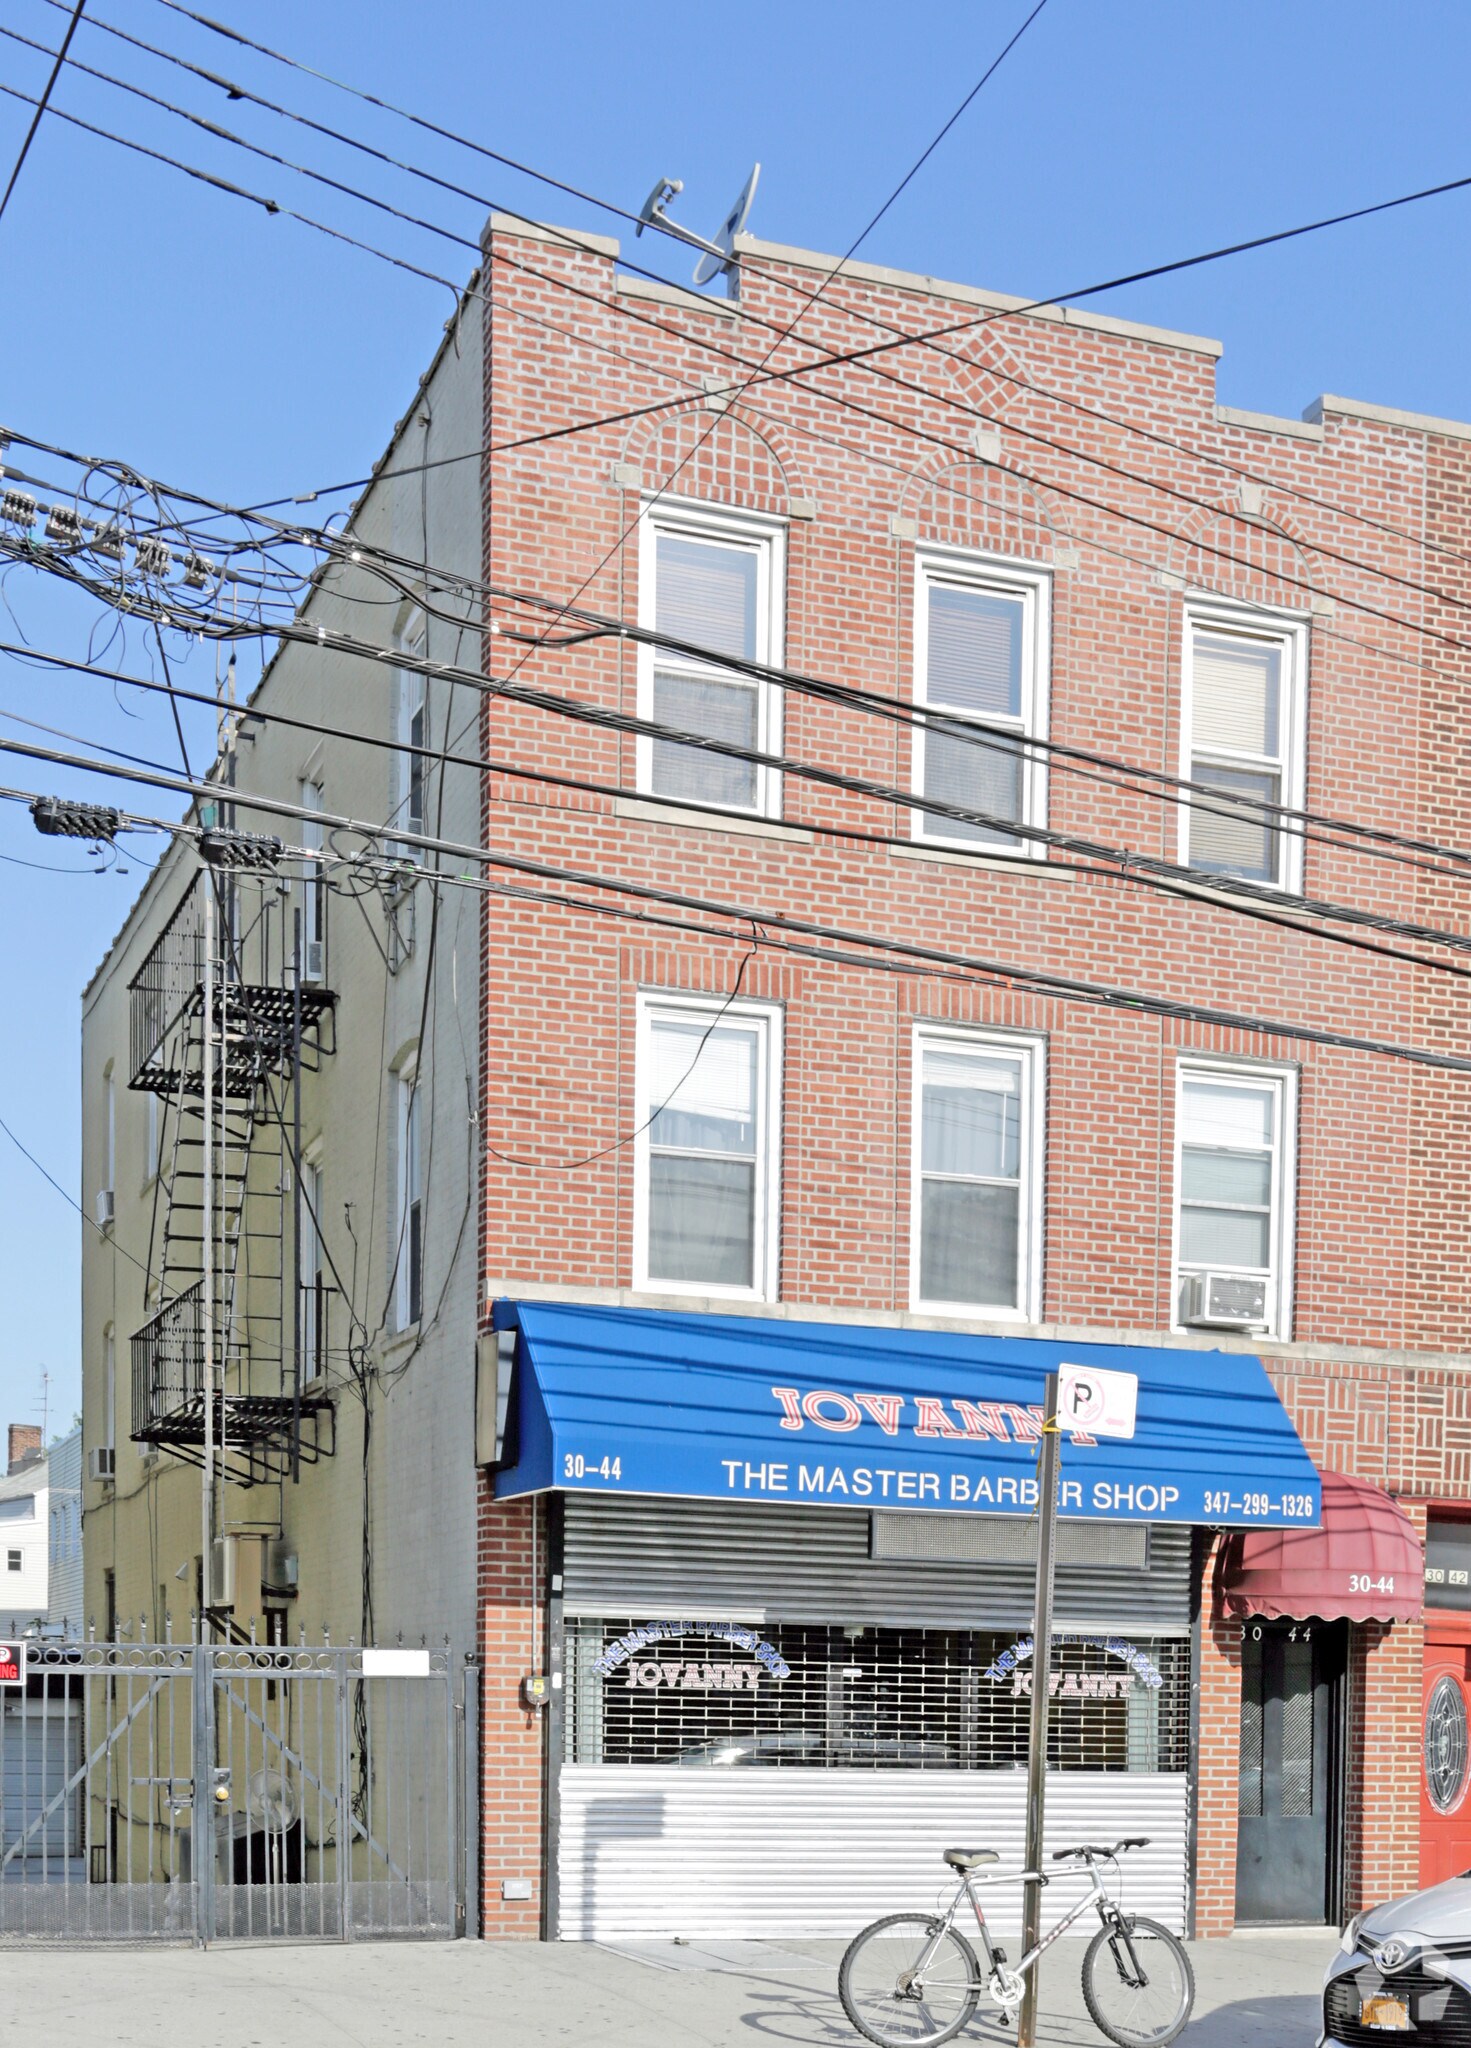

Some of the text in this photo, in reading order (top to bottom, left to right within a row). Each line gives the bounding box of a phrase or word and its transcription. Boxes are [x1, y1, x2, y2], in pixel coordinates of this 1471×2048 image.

[771, 1387, 1098, 1447] JOVANN
[564, 1453, 622, 1481] 30-44
[721, 1460, 789, 1491] THE
[799, 1466, 940, 1500] MASTER
[1093, 1482, 1180, 1512] SHOP
[1203, 1491, 1313, 1518] 347-299-1326
[1348, 1574, 1395, 1594] 30-44
[1426, 1570, 1467, 1583] 30 42
[592, 1640, 629, 1677] THE
[984, 1651, 1019, 1682] THE
[625, 1662, 764, 1689] JOVANNY
